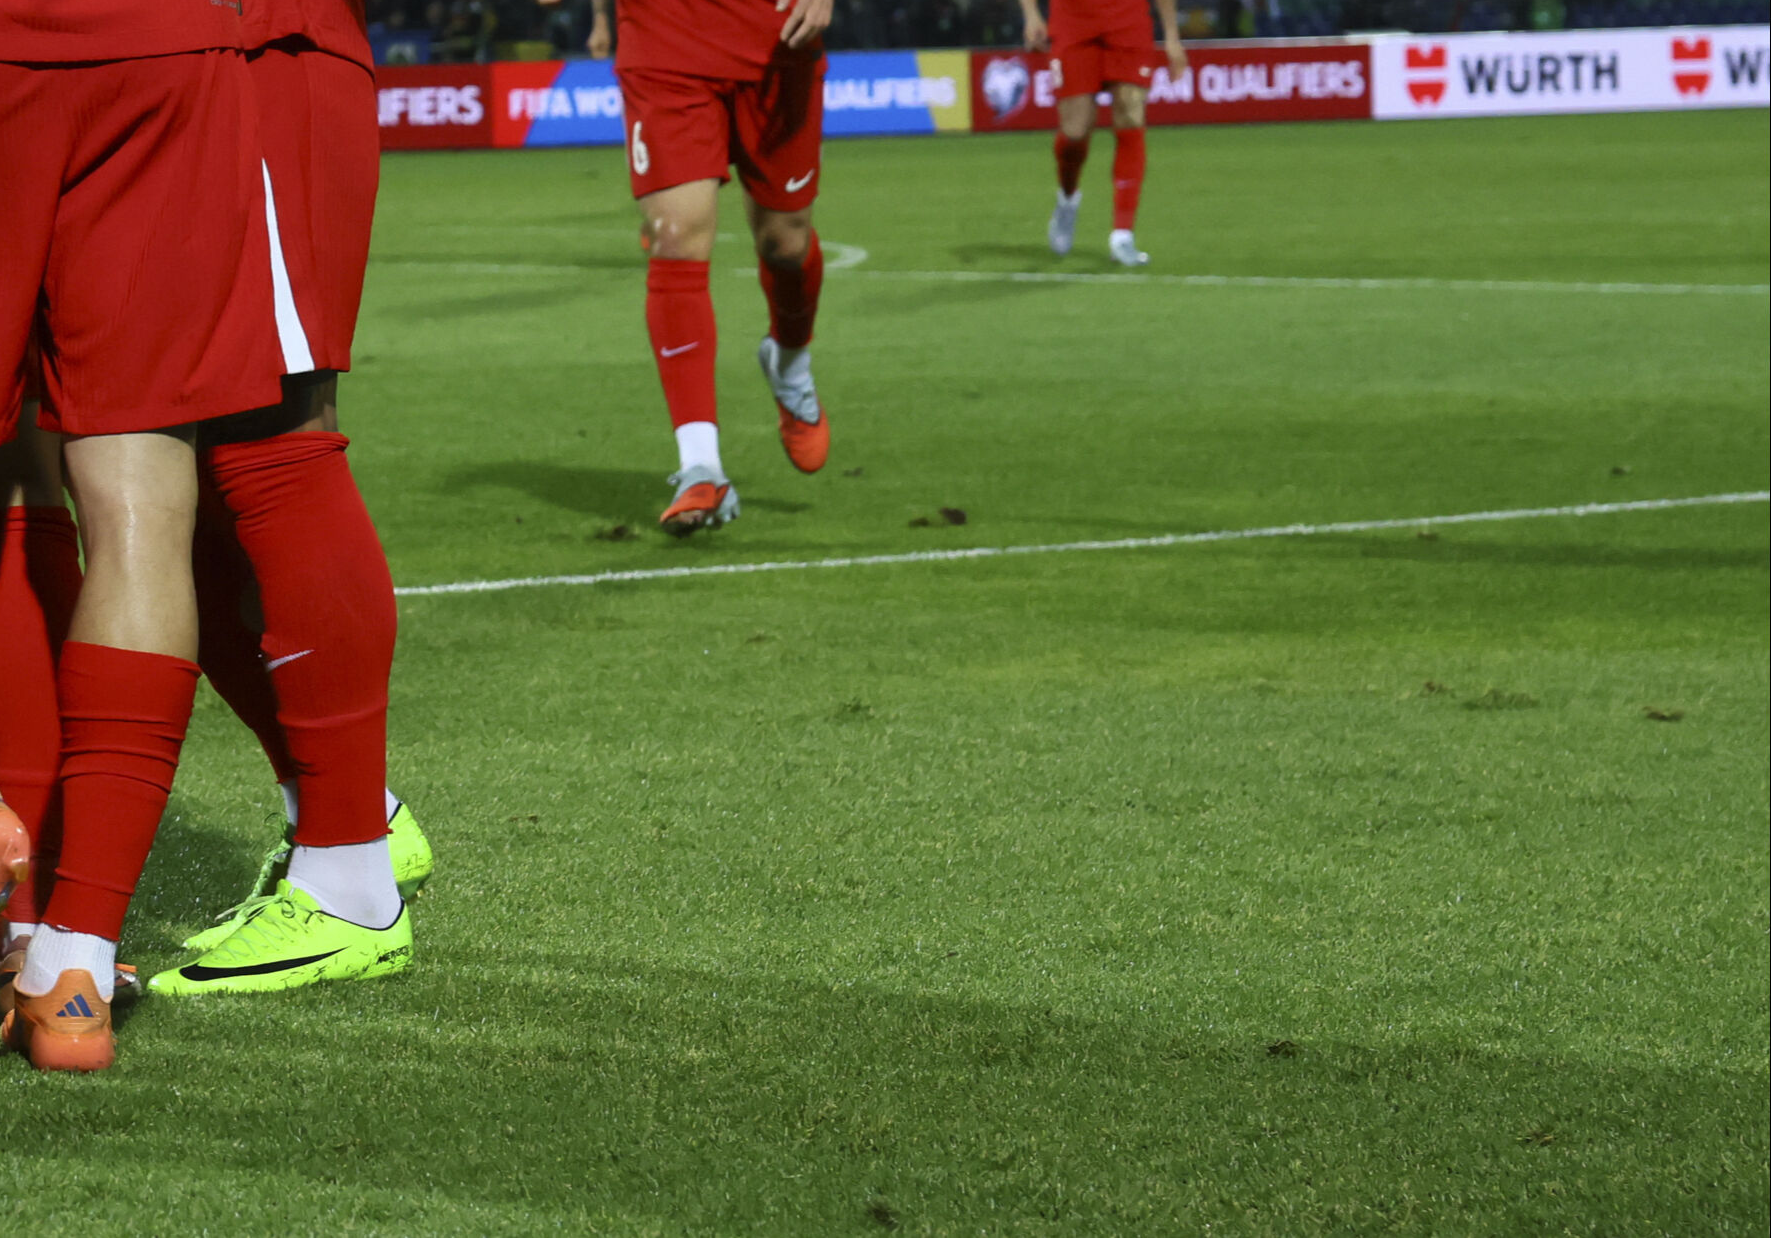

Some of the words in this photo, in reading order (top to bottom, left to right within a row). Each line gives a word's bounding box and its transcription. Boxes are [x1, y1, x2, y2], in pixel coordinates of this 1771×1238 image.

[508, 87, 572, 120] FIFA
[823, 76, 957, 110] UALIFIERS
[1199, 61, 1365, 103] QUALIFIERS
[378, 85, 484, 127] IFIERS
[632, 120, 650, 175] 6
